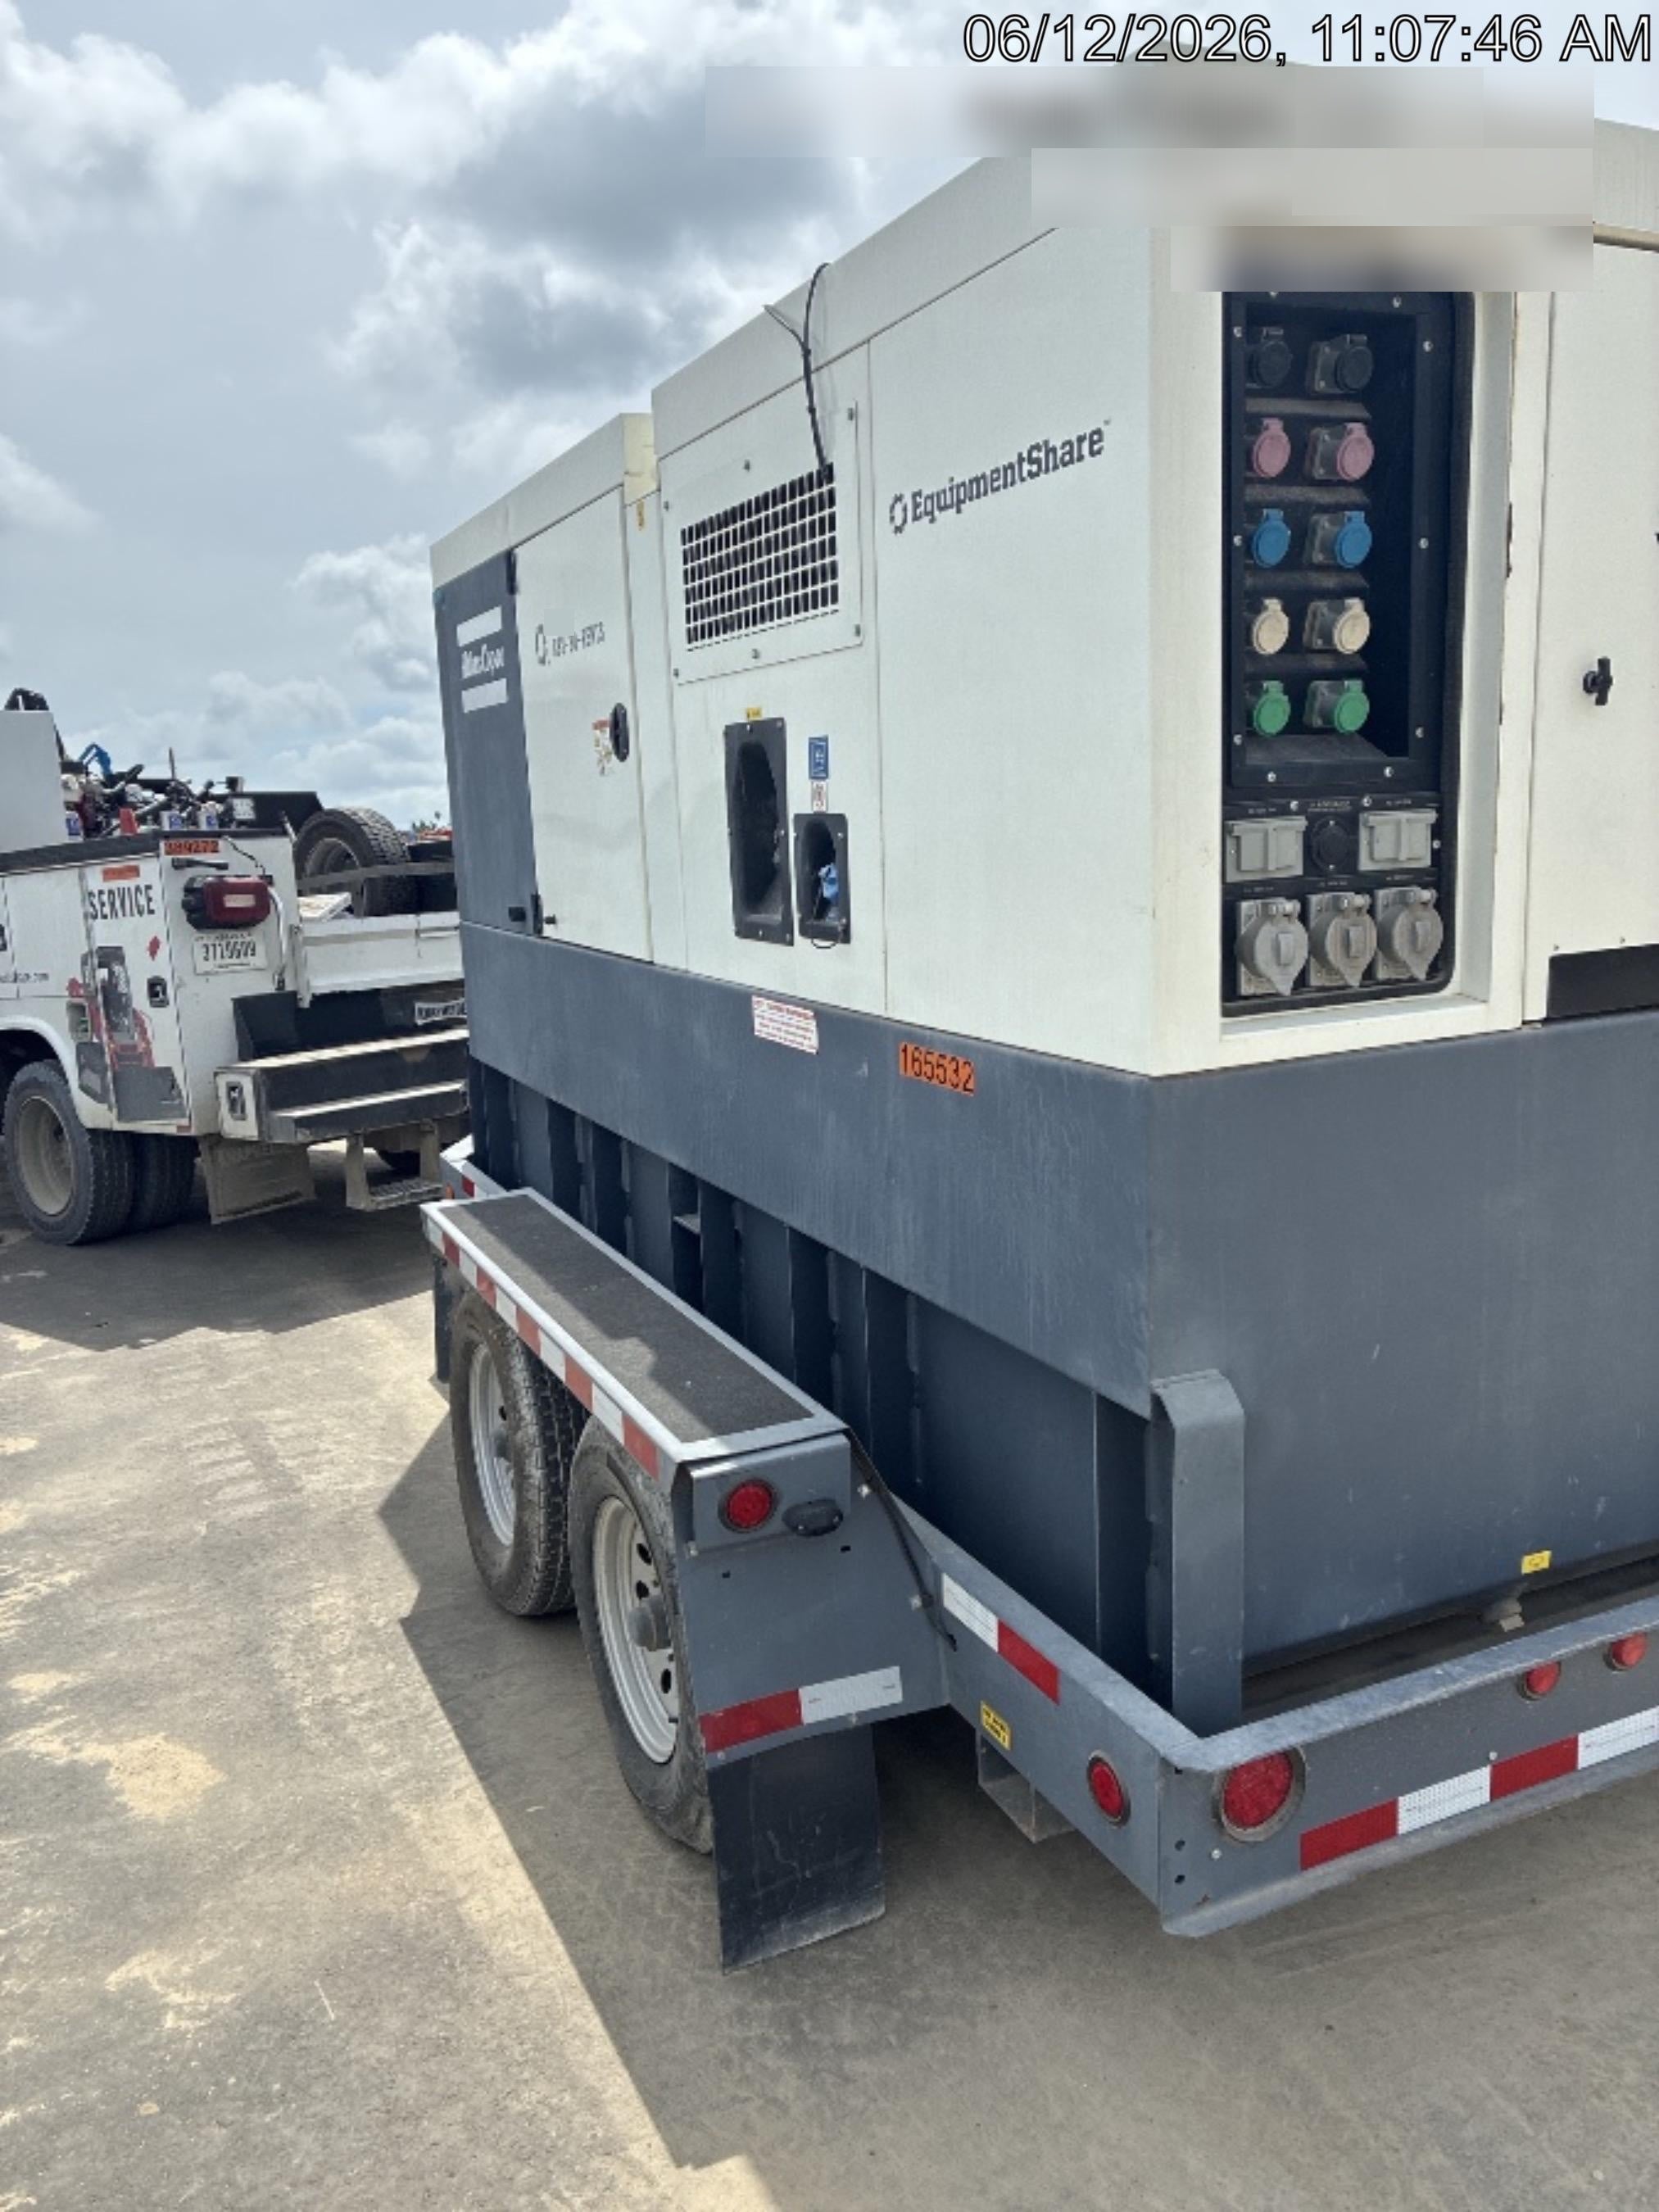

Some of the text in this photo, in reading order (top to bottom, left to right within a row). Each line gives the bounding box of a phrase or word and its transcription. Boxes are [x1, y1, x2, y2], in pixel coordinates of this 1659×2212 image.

[911, 425, 1104, 524] EquipmentShare
[88, 884, 155, 920] SERVICE
[900, 1043, 974, 1093] 165532
